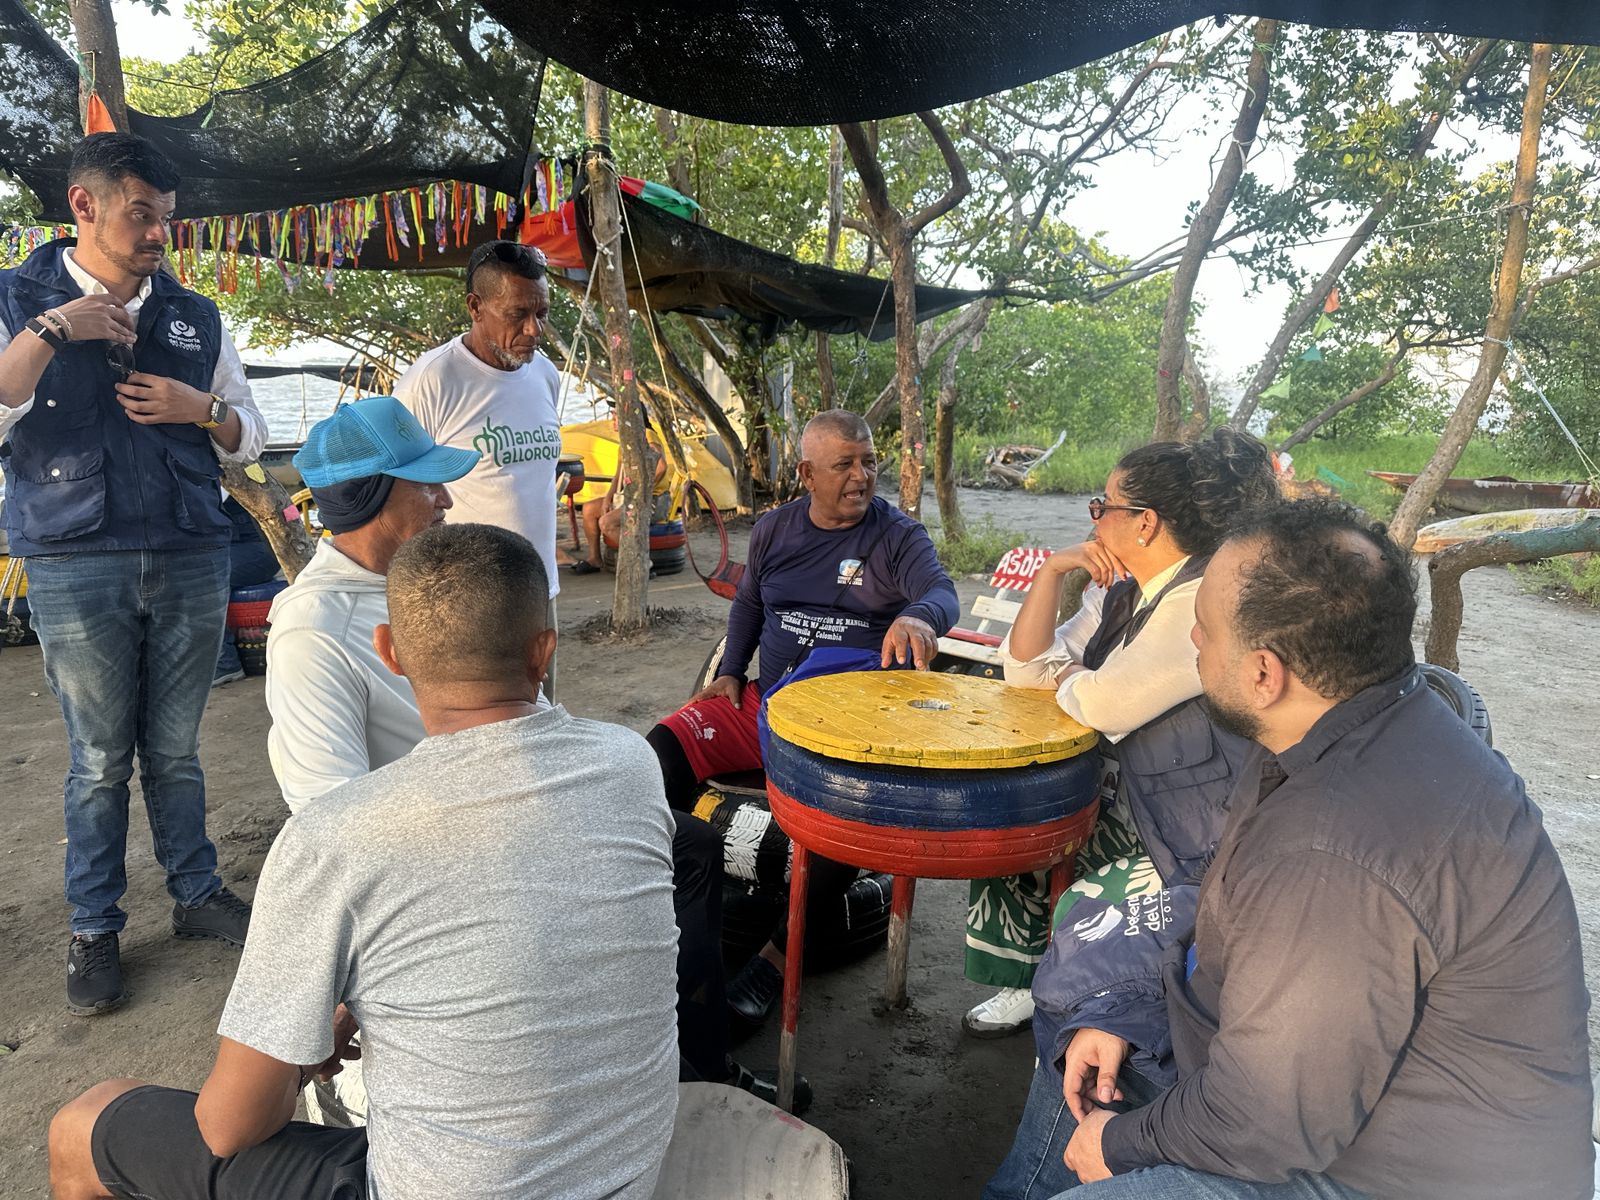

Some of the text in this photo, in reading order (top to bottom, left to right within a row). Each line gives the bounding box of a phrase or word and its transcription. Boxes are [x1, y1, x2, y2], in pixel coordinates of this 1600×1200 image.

[994, 551, 1046, 579] ASOP
[815, 631, 842, 641] Colombia
[1143, 905, 1161, 932] del
